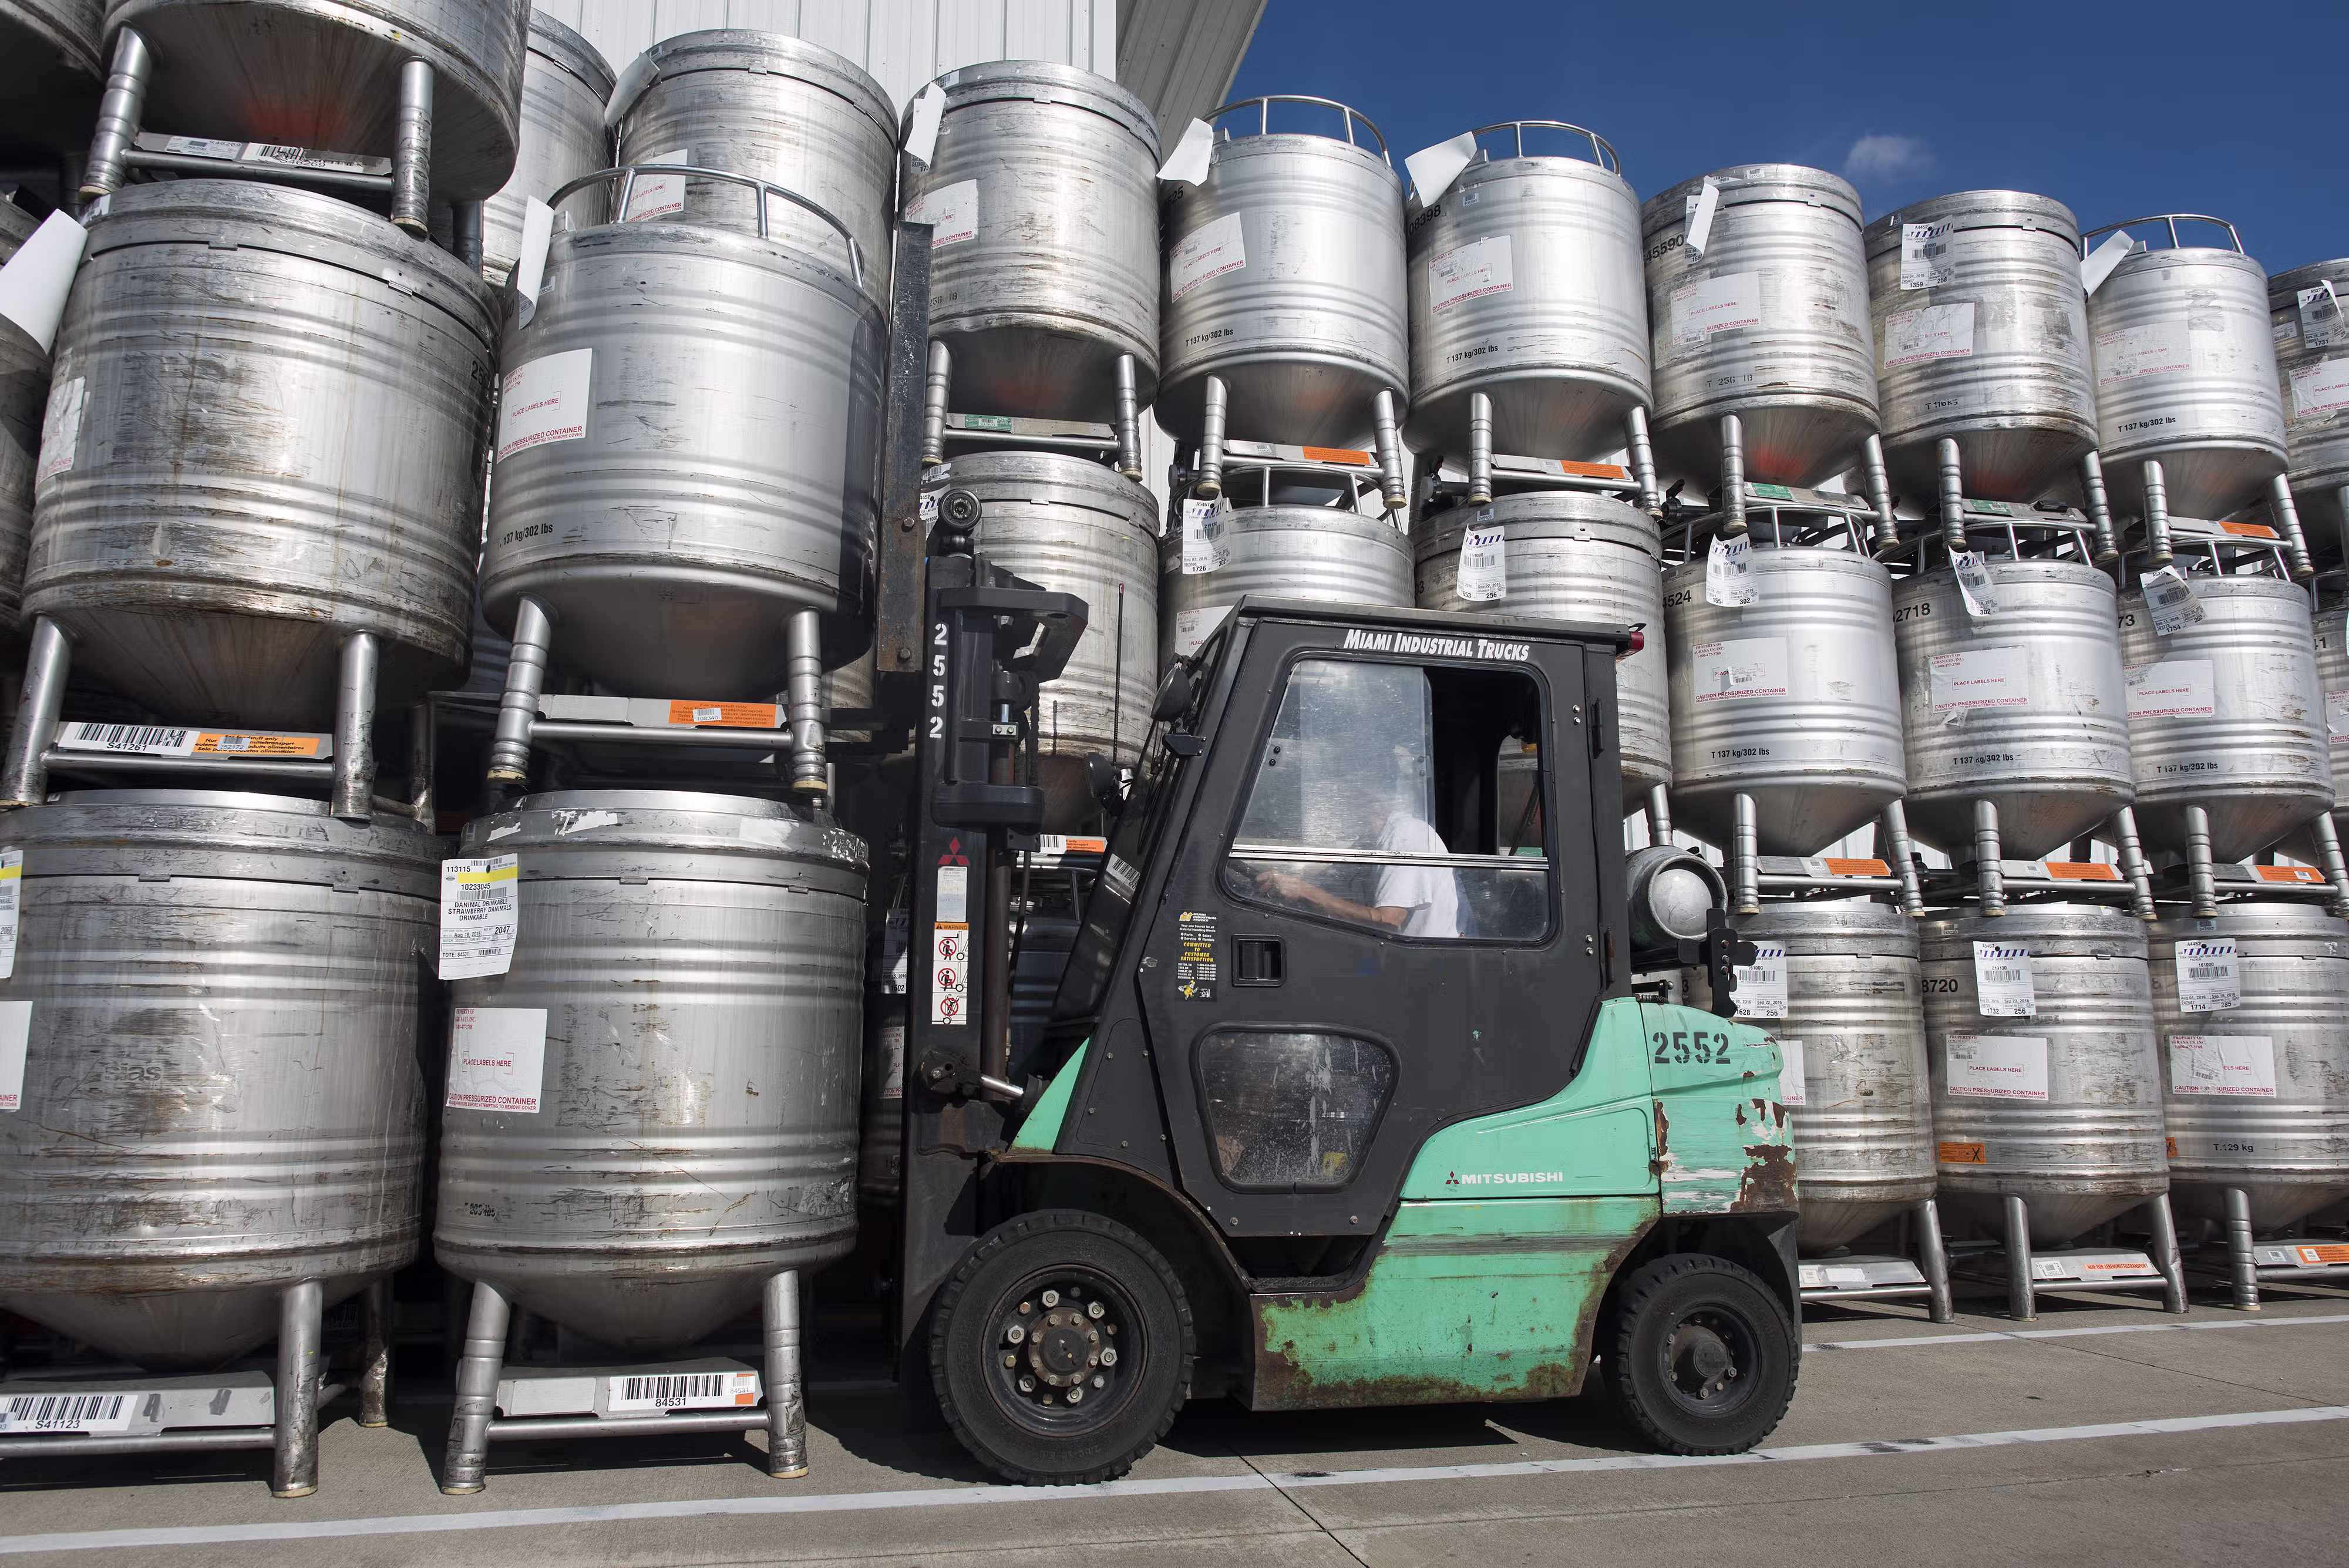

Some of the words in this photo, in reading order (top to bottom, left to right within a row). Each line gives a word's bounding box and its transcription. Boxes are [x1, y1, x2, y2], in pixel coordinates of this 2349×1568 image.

[280, 158, 327, 168] S46269
[654, 202, 682, 213] CONTAINER
[945, 230, 972, 241] CONTAINER
[1210, 246, 1222, 255] HERE
[1644, 234, 1685, 268] 45590
[1216, 260, 1244, 272] CONTAINER
[1432, 300, 1450, 311] CAUTION
[1450, 288, 1482, 304] PRESSURIZED
[1482, 282, 1512, 293] CONTAINER
[1691, 308, 1705, 316] PLACE
[1705, 304, 1724, 312] LABELS
[1728, 318, 1759, 327] CONTAINER
[1190, 335, 1200, 345] 137
[1202, 329, 1222, 342] kg/302
[1224, 328, 1234, 337] lbs
[1451, 352, 1463, 362] 137
[1464, 347, 1486, 359] kg/302
[1886, 357, 1905, 366] CAUTION
[1906, 351, 1940, 361] PRESSURIZED
[1718, 376, 1736, 386] 256
[512, 407, 525, 418] PLACE
[525, 401, 543, 412] LABELS
[544, 398, 559, 406] HERE
[2297, 406, 2320, 415] CAUTION
[2124, 422, 2138, 432] 137
[2139, 418, 2164, 429] kg/302
[2165, 416, 2176, 425] lbs
[511, 432, 545, 449] PRESSURIZED
[546, 426, 583, 438] CONTAINER
[514, 524, 539, 542] kg/302
[540, 523, 553, 534] lbs
[1218, 557, 1226, 567] 302
[2166, 624, 2181, 633] 1754
[2193, 614, 2203, 624] 302
[1342, 628, 1392, 650] MIAMI
[1393, 632, 1473, 658] INDUSTRIAL
[1477, 639, 1530, 661] TRUCKS
[929, 623, 948, 739] 2552
[1717, 689, 1754, 698] PRESSURIZED
[106, 742, 148, 752] S41261
[1711, 751, 1717, 759] T
[1717, 750, 1731, 759] 137
[1732, 748, 1757, 759] kg/302
[1759, 748, 1770, 756] lbs
[1953, 758, 1958, 766] T
[1960, 756, 1974, 765] 137
[2157, 766, 2162, 774] T
[2163, 764, 2178, 773] 137
[2179, 762, 2205, 773] kg/302
[2207, 762, 2219, 770] lbs
[460, 883, 491, 891] 10233045
[482, 898, 509, 907] DRINKABLE
[448, 906, 487, 914] STRAWBERRY
[487, 904, 512, 913] DANIMALS
[495, 926, 510, 934] 2047
[1921, 978, 1959, 993] 8720
[1652, 1031, 1731, 1065] 2552
[463, 1058, 477, 1066] PLACE
[463, 1094, 497, 1103] PRESSURIZED
[497, 1096, 537, 1105] CONTAINER
[2242, 1143, 2254, 1153] kg
[1461, 1172, 1564, 1185] MITSUBISHI
[655, 1397, 686, 1407] 84531
[35, 1419, 80, 1429] S41123
